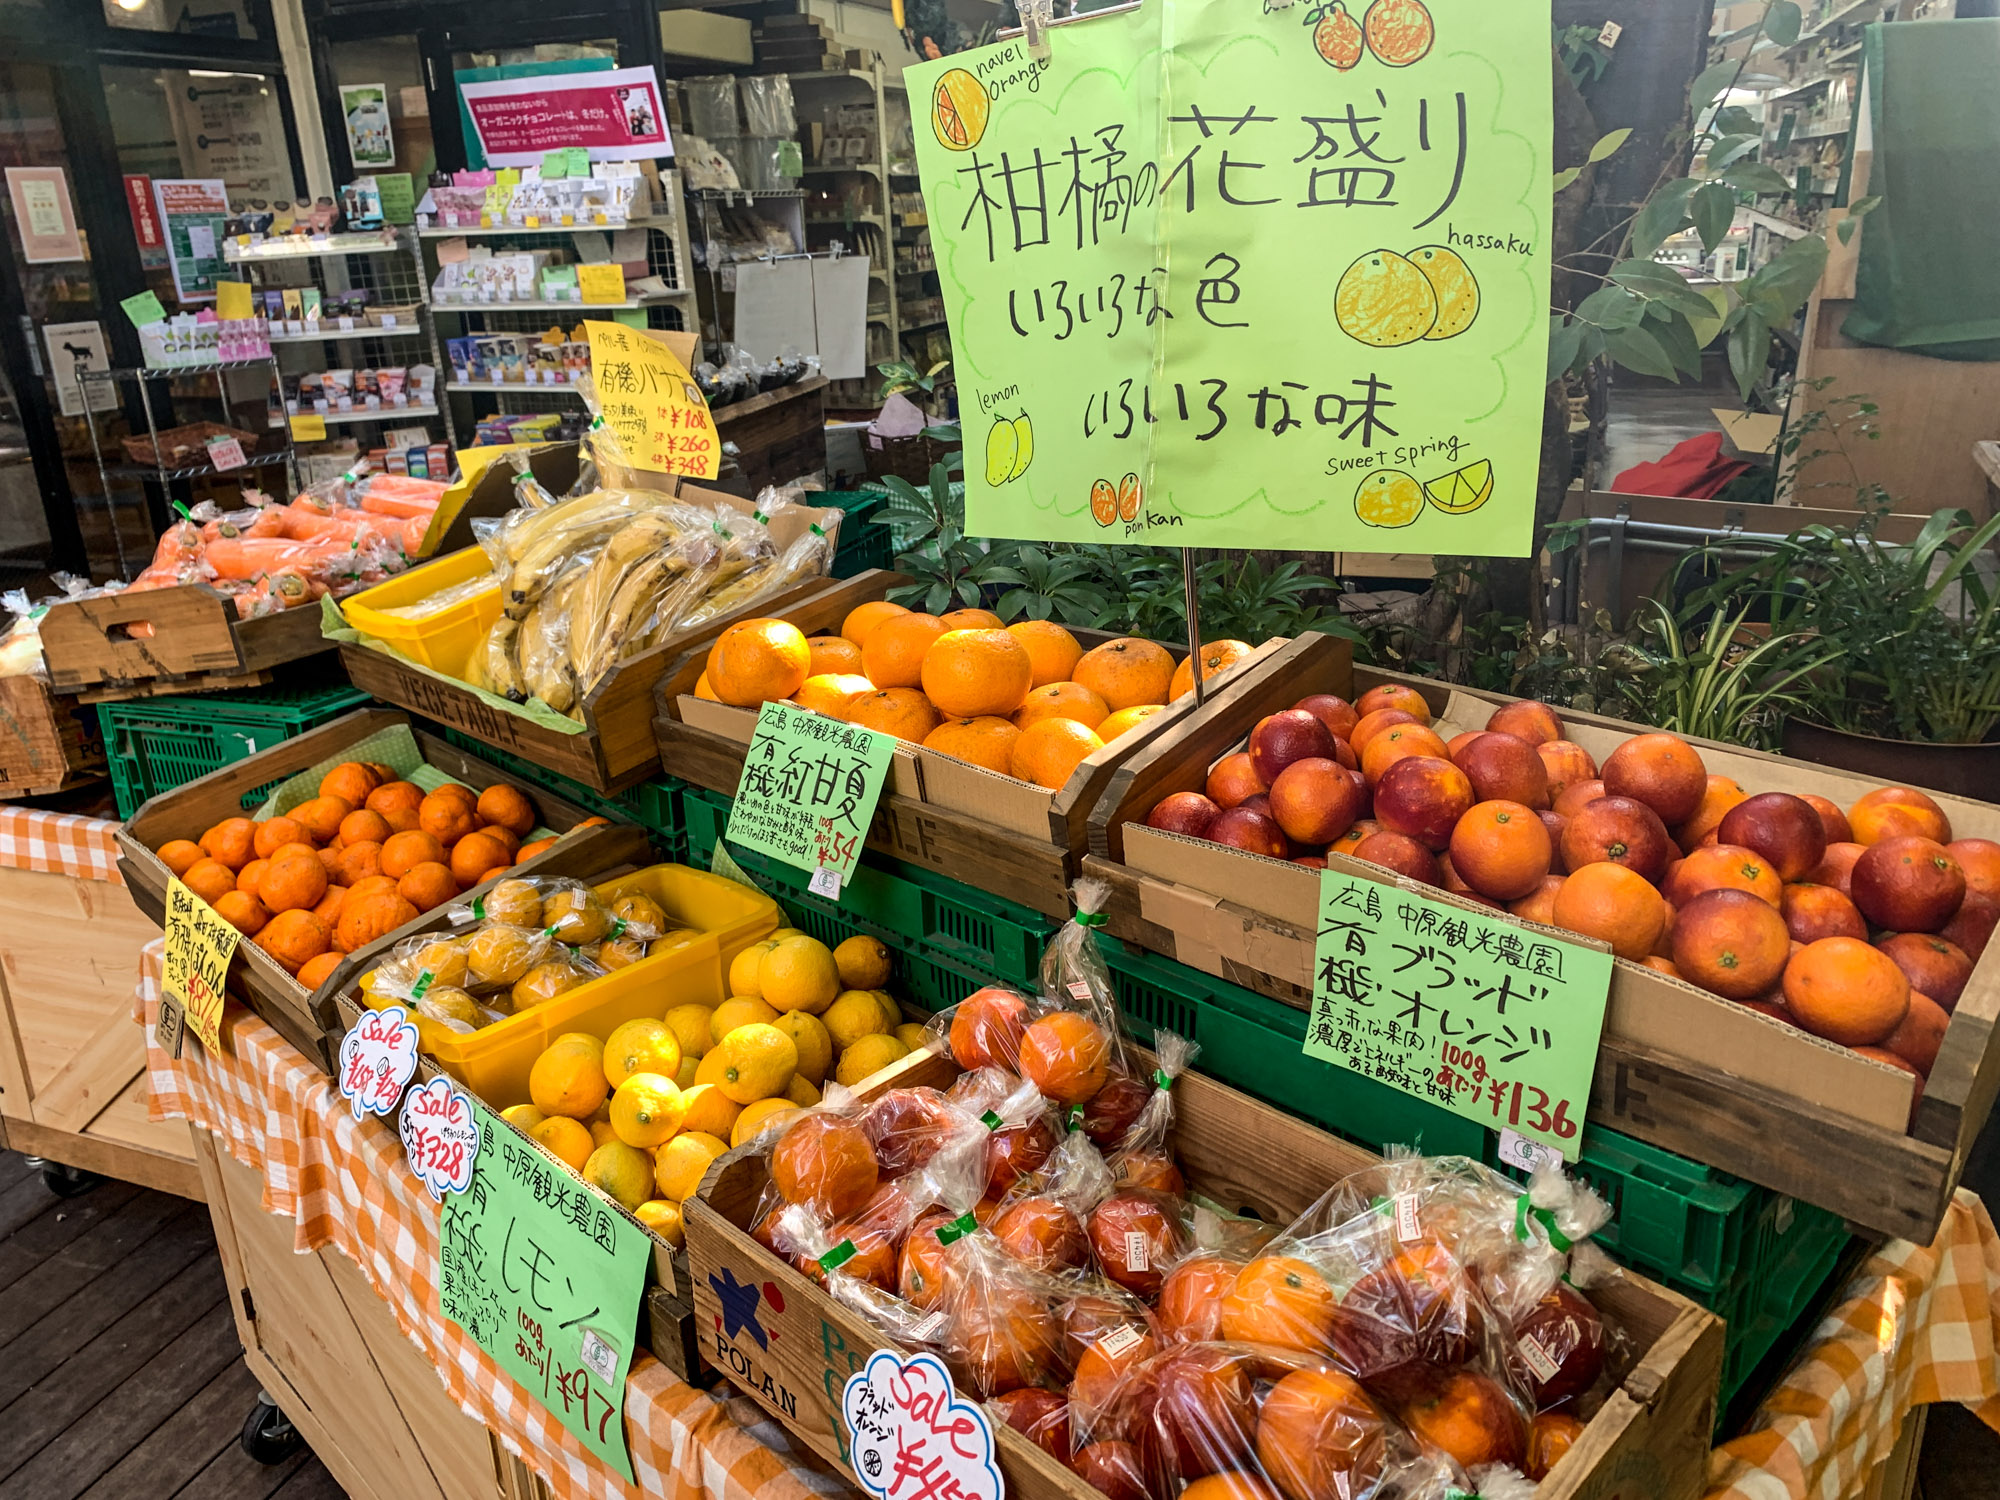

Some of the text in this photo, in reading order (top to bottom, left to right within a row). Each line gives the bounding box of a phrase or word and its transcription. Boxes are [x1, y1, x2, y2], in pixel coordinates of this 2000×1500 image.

[976, 43, 1024, 78] navel
[957, 88, 1468, 262] 柑橘の花盛り
[1447, 223, 1534, 257] hassaku
[1008, 252, 1250, 340] いろいろな色
[671, 405, 707, 430] ¥108
[976, 382, 1020, 414] lemon
[1083, 372, 1400, 448] いろいろな味
[664, 454, 709, 477] ¥348
[667, 433, 710, 454] ¥260
[1325, 435, 1470, 476] sweet spring
[757, 705, 873, 755] 広島 中原観光農園
[816, 831, 859, 870] ¥54
[1329, 881, 1567, 984] 広島 中原観光農園
[1391, 943, 1549, 1015] ブラッド
[362, 1018, 403, 1050] Sale
[1391, 988, 1552, 1063] オレンジ
[1435, 1065, 1483, 1104] あたり
[1441, 1040, 1490, 1084] 100g
[413, 1090, 463, 1125] Sale
[1487, 1079, 1578, 1139] ¥136
[414, 1126, 464, 1181] ¥328
[503, 1143, 616, 1256] 中原観光農園
[502, 1217, 600, 1330] レモン
[517, 1306, 546, 1352] 100g
[715, 1332, 798, 1420] POLAN
[555, 1360, 616, 1445] ¥97
[858, 1380, 895, 1420] ブラッド
[855, 1407, 895, 1442] オレンジ
